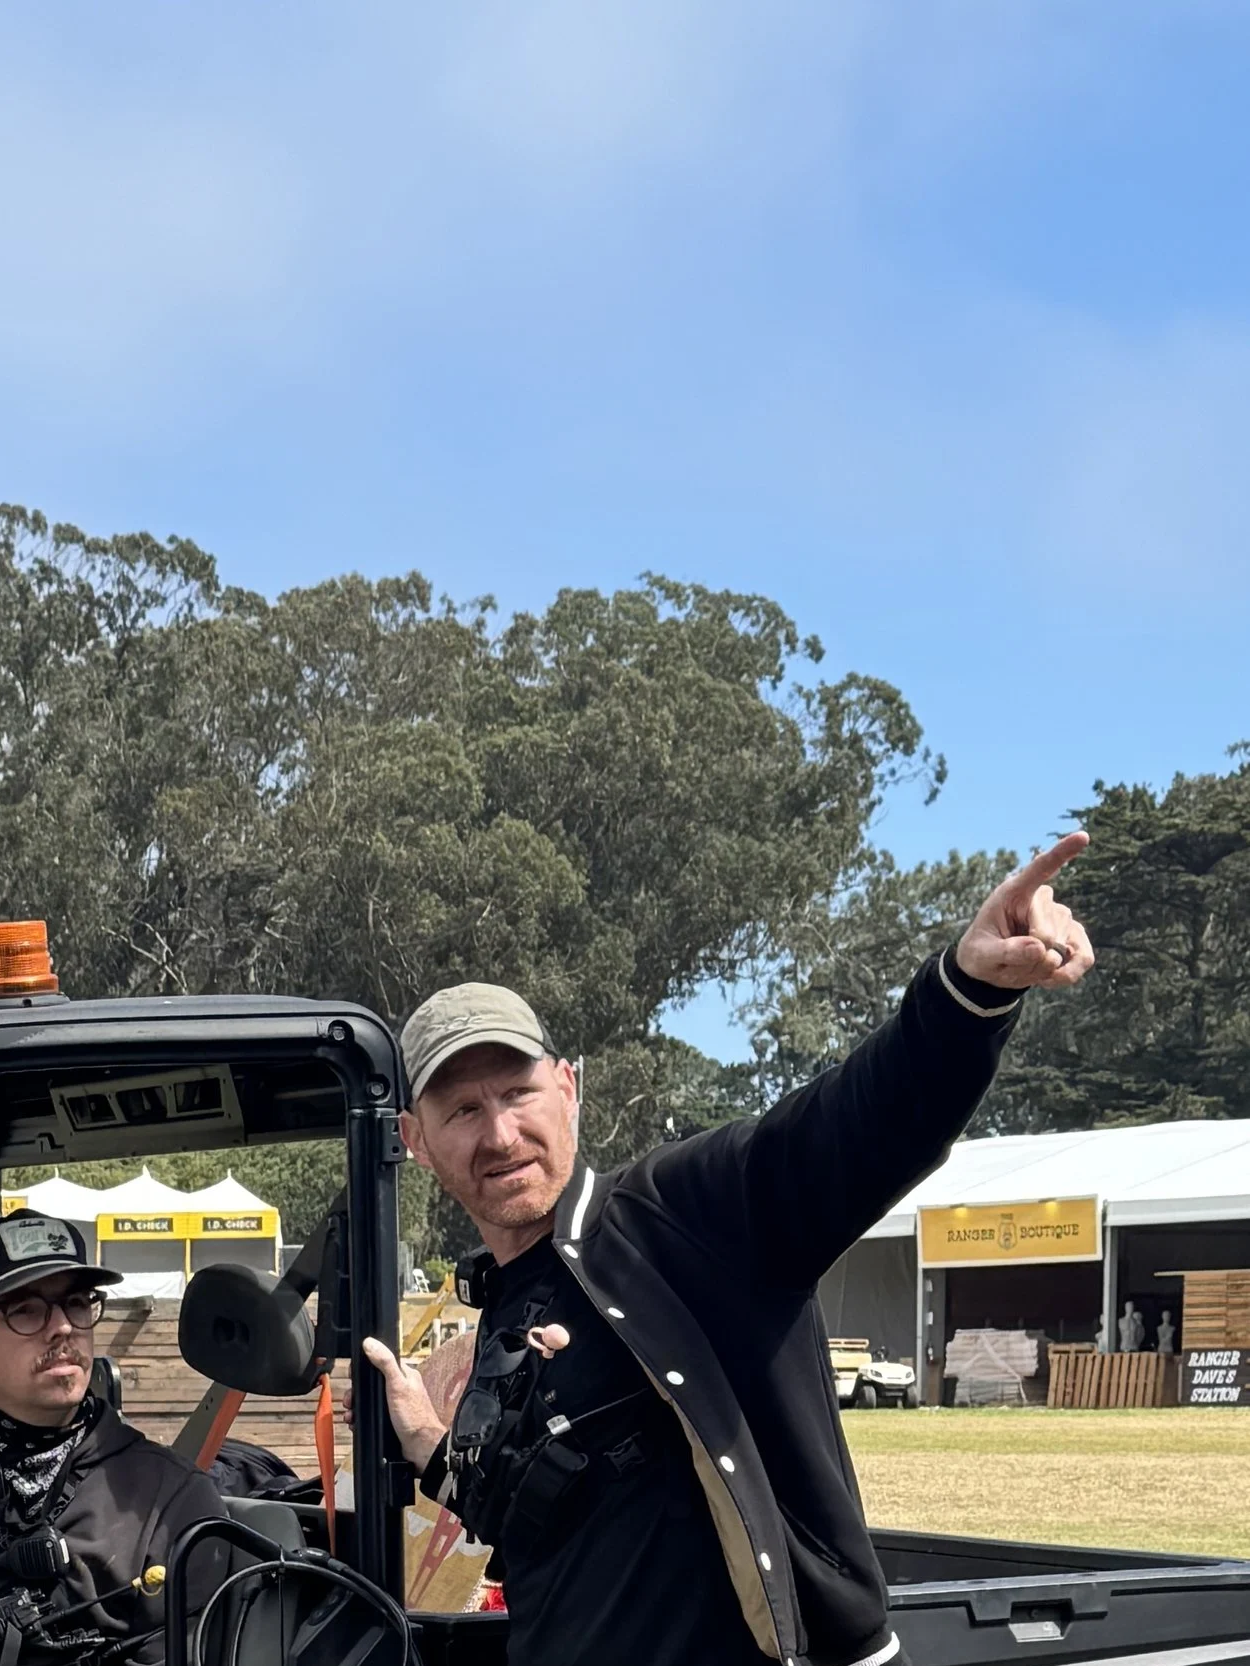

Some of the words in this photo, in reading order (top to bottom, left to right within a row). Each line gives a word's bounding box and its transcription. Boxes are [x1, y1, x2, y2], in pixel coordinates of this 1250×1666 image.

[136, 1221, 169, 1230] CHECK
[225, 1220, 258, 1229] CHECK
[947, 1229, 995, 1243] RANGER
[1020, 1223, 1080, 1239] BOUTIQUE
[1188, 1350, 1241, 1367] RANGER
[1190, 1386, 1241, 1402] STATION
